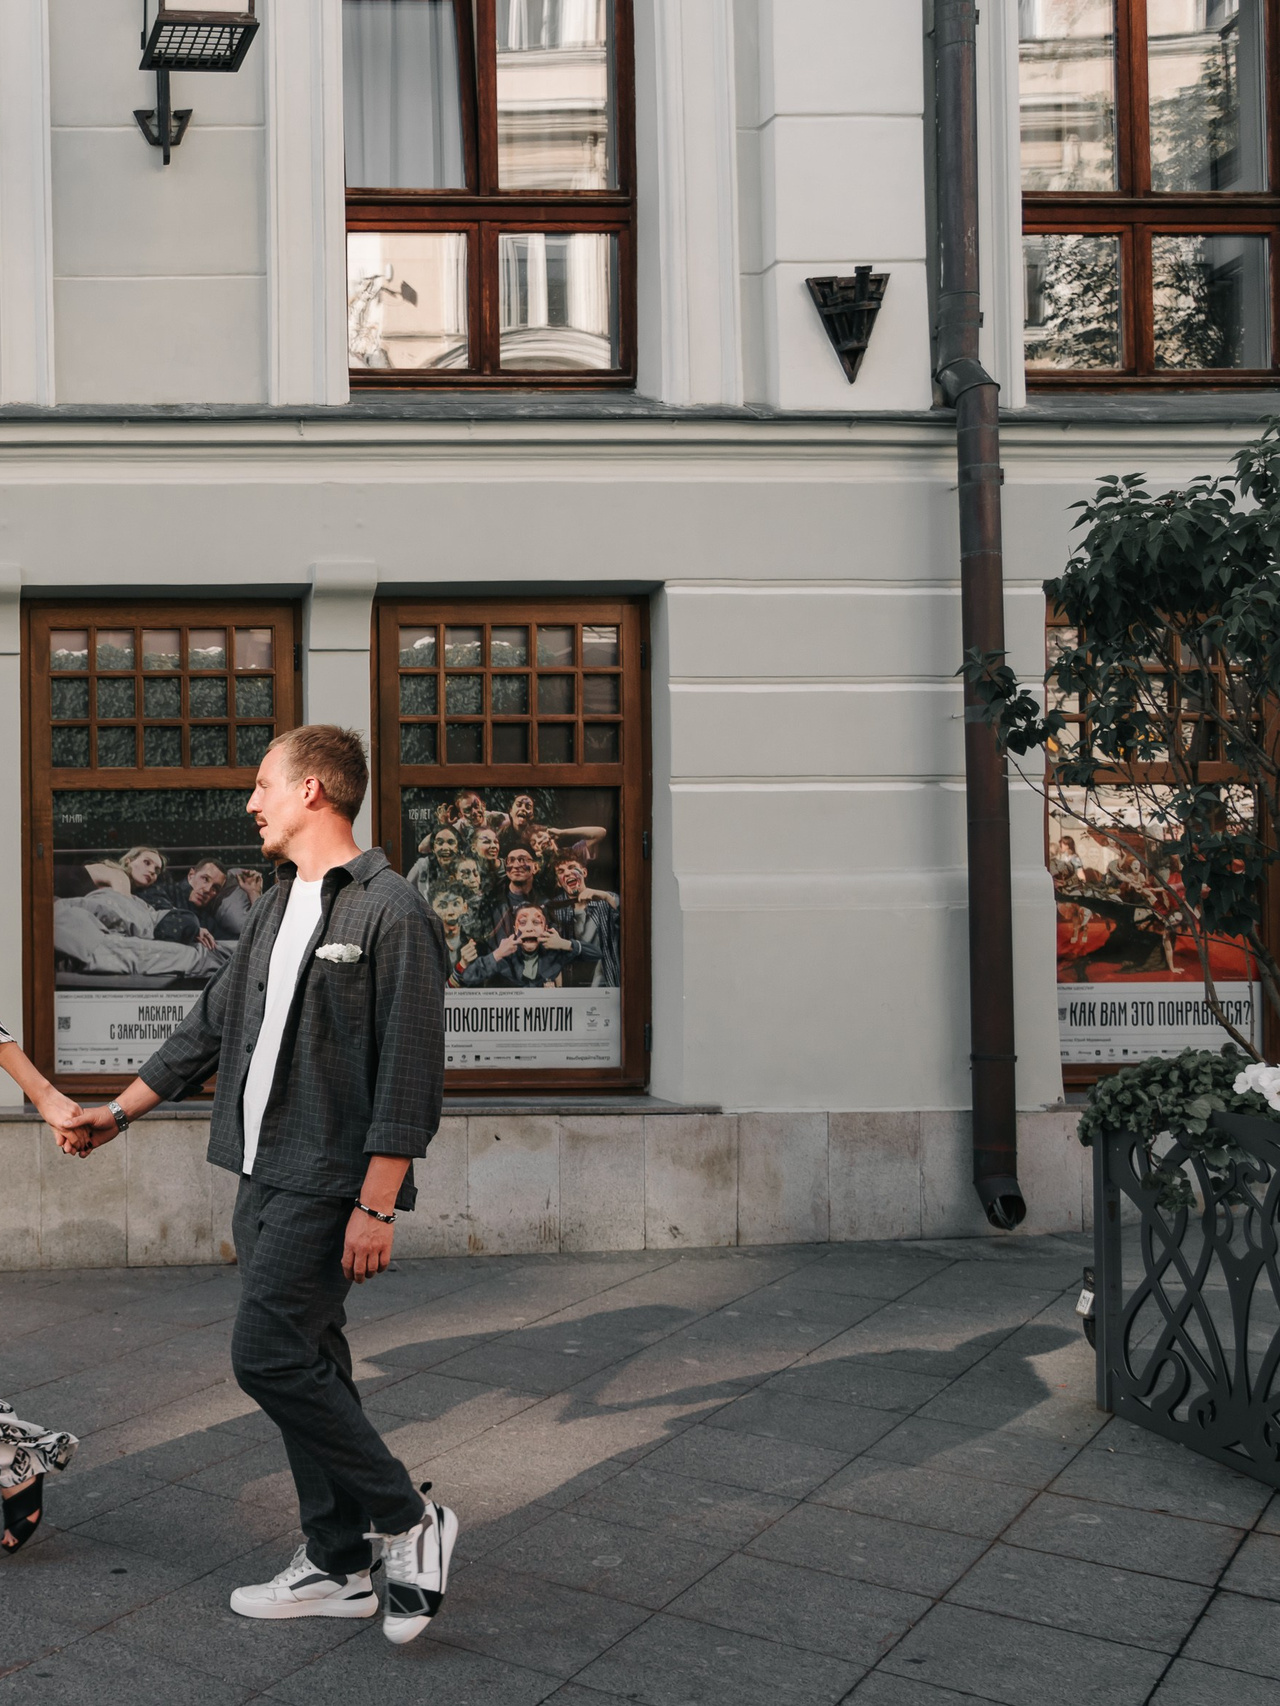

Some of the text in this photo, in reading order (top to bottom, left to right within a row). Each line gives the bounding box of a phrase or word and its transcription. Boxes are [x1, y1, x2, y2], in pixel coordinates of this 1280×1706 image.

[138, 1005, 183, 1022] МАСКАРАД
[445, 1007, 520, 1032] ПОКОЛЕНИЕ
[524, 1006, 573, 1032] МАУГЛИ
[1070, 1002, 1097, 1026] КАК
[1100, 1002, 1127, 1026] ВАМ
[1131, 1001, 1154, 1026] ЭТО
[110, 1024, 115, 1039] С
[117, 1024, 172, 1039] ЗАКРЫТЫМИ
